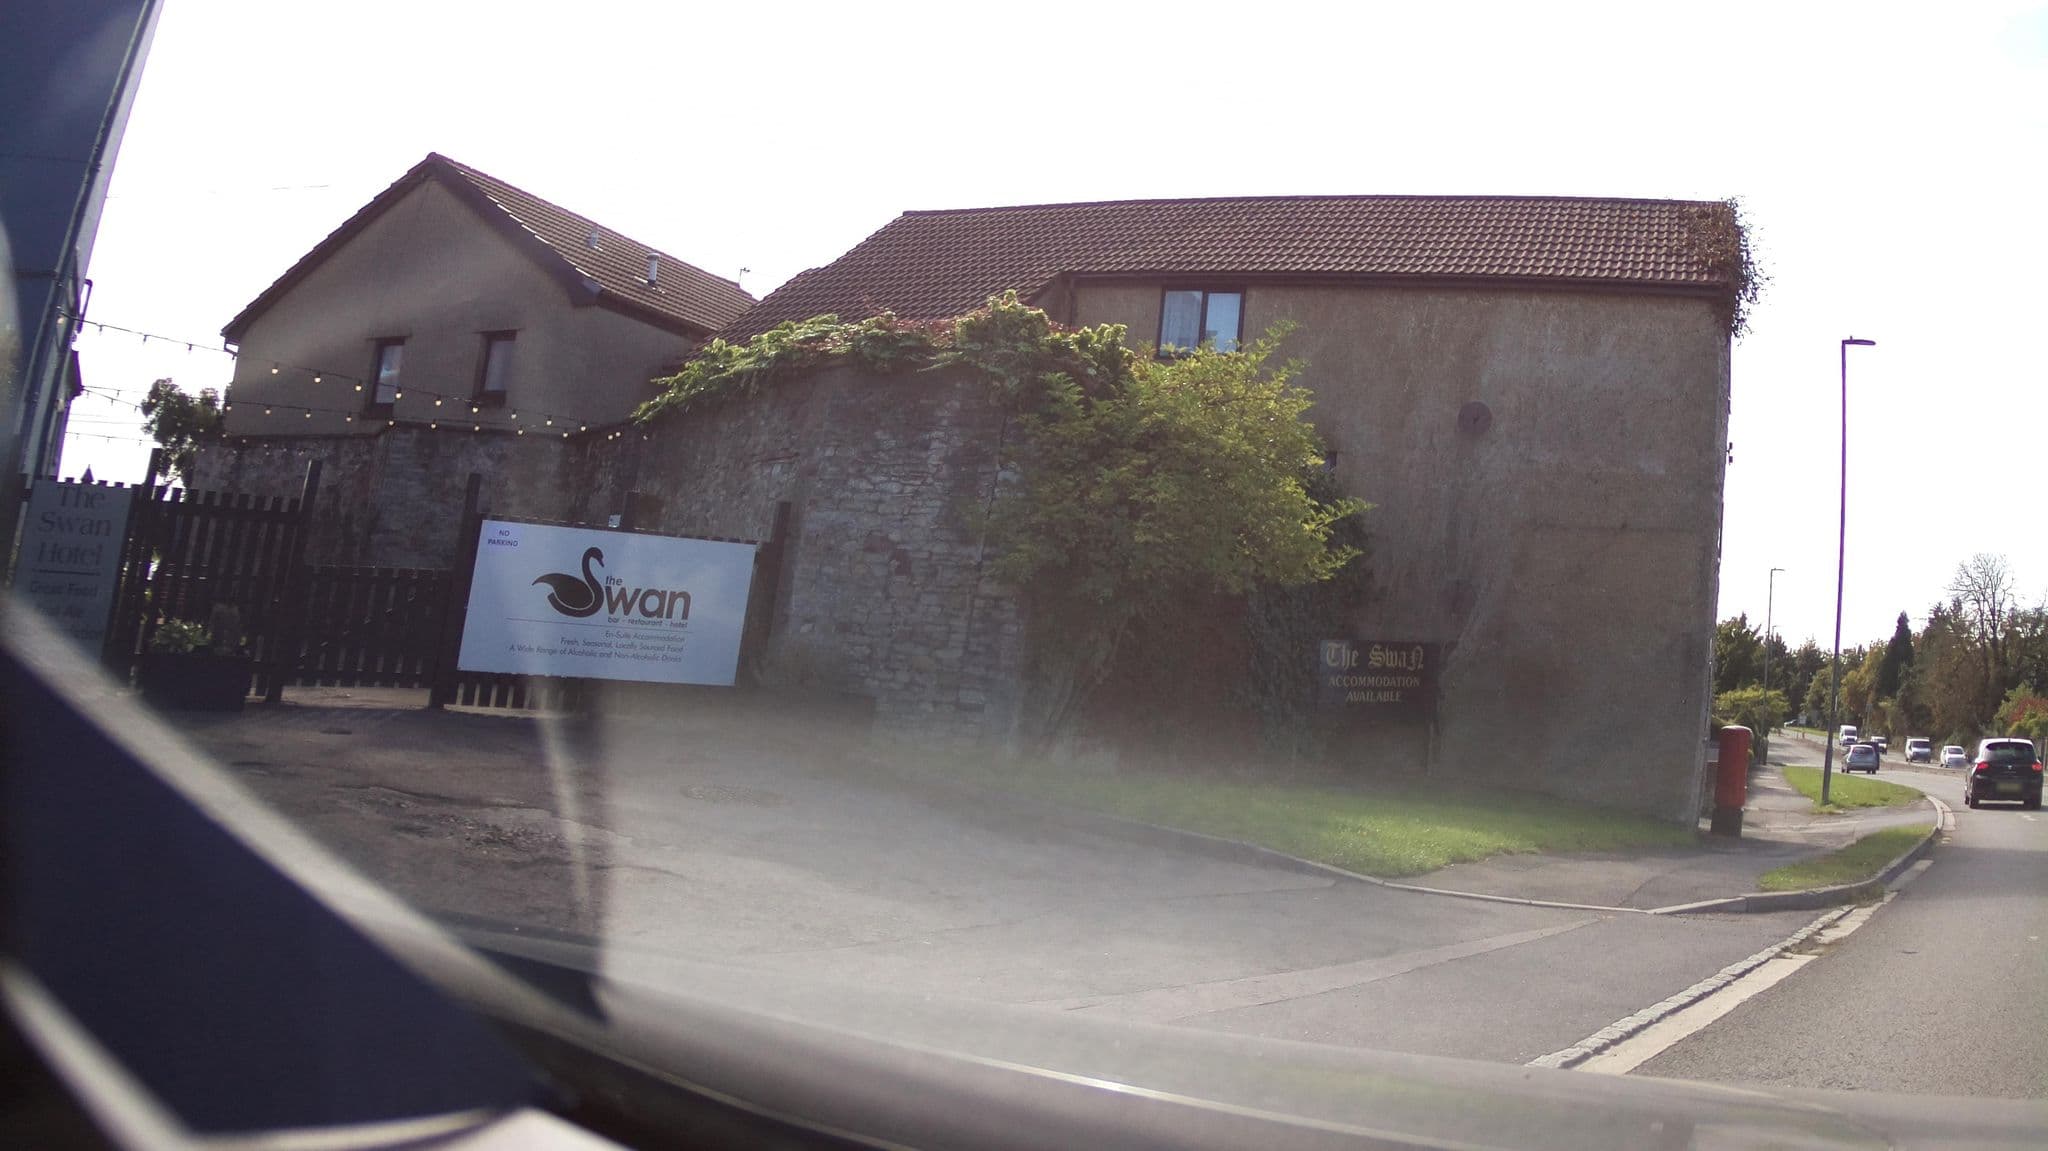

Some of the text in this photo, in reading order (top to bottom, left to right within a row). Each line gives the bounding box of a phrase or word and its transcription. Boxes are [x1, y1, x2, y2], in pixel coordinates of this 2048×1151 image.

[58, 486, 105, 509] The
[38, 511, 111, 537] Swan
[498, 529, 511, 537] NO
[37, 541, 104, 566] Hotel
[605, 575, 623, 586] the
[608, 616, 619, 624] bar
[627, 617, 663, 627] restaurant
[1326, 641, 1360, 670] The
[1328, 675, 1421, 688] ACCOMMODATION
[1345, 690, 1402, 703] AVAILABLE
